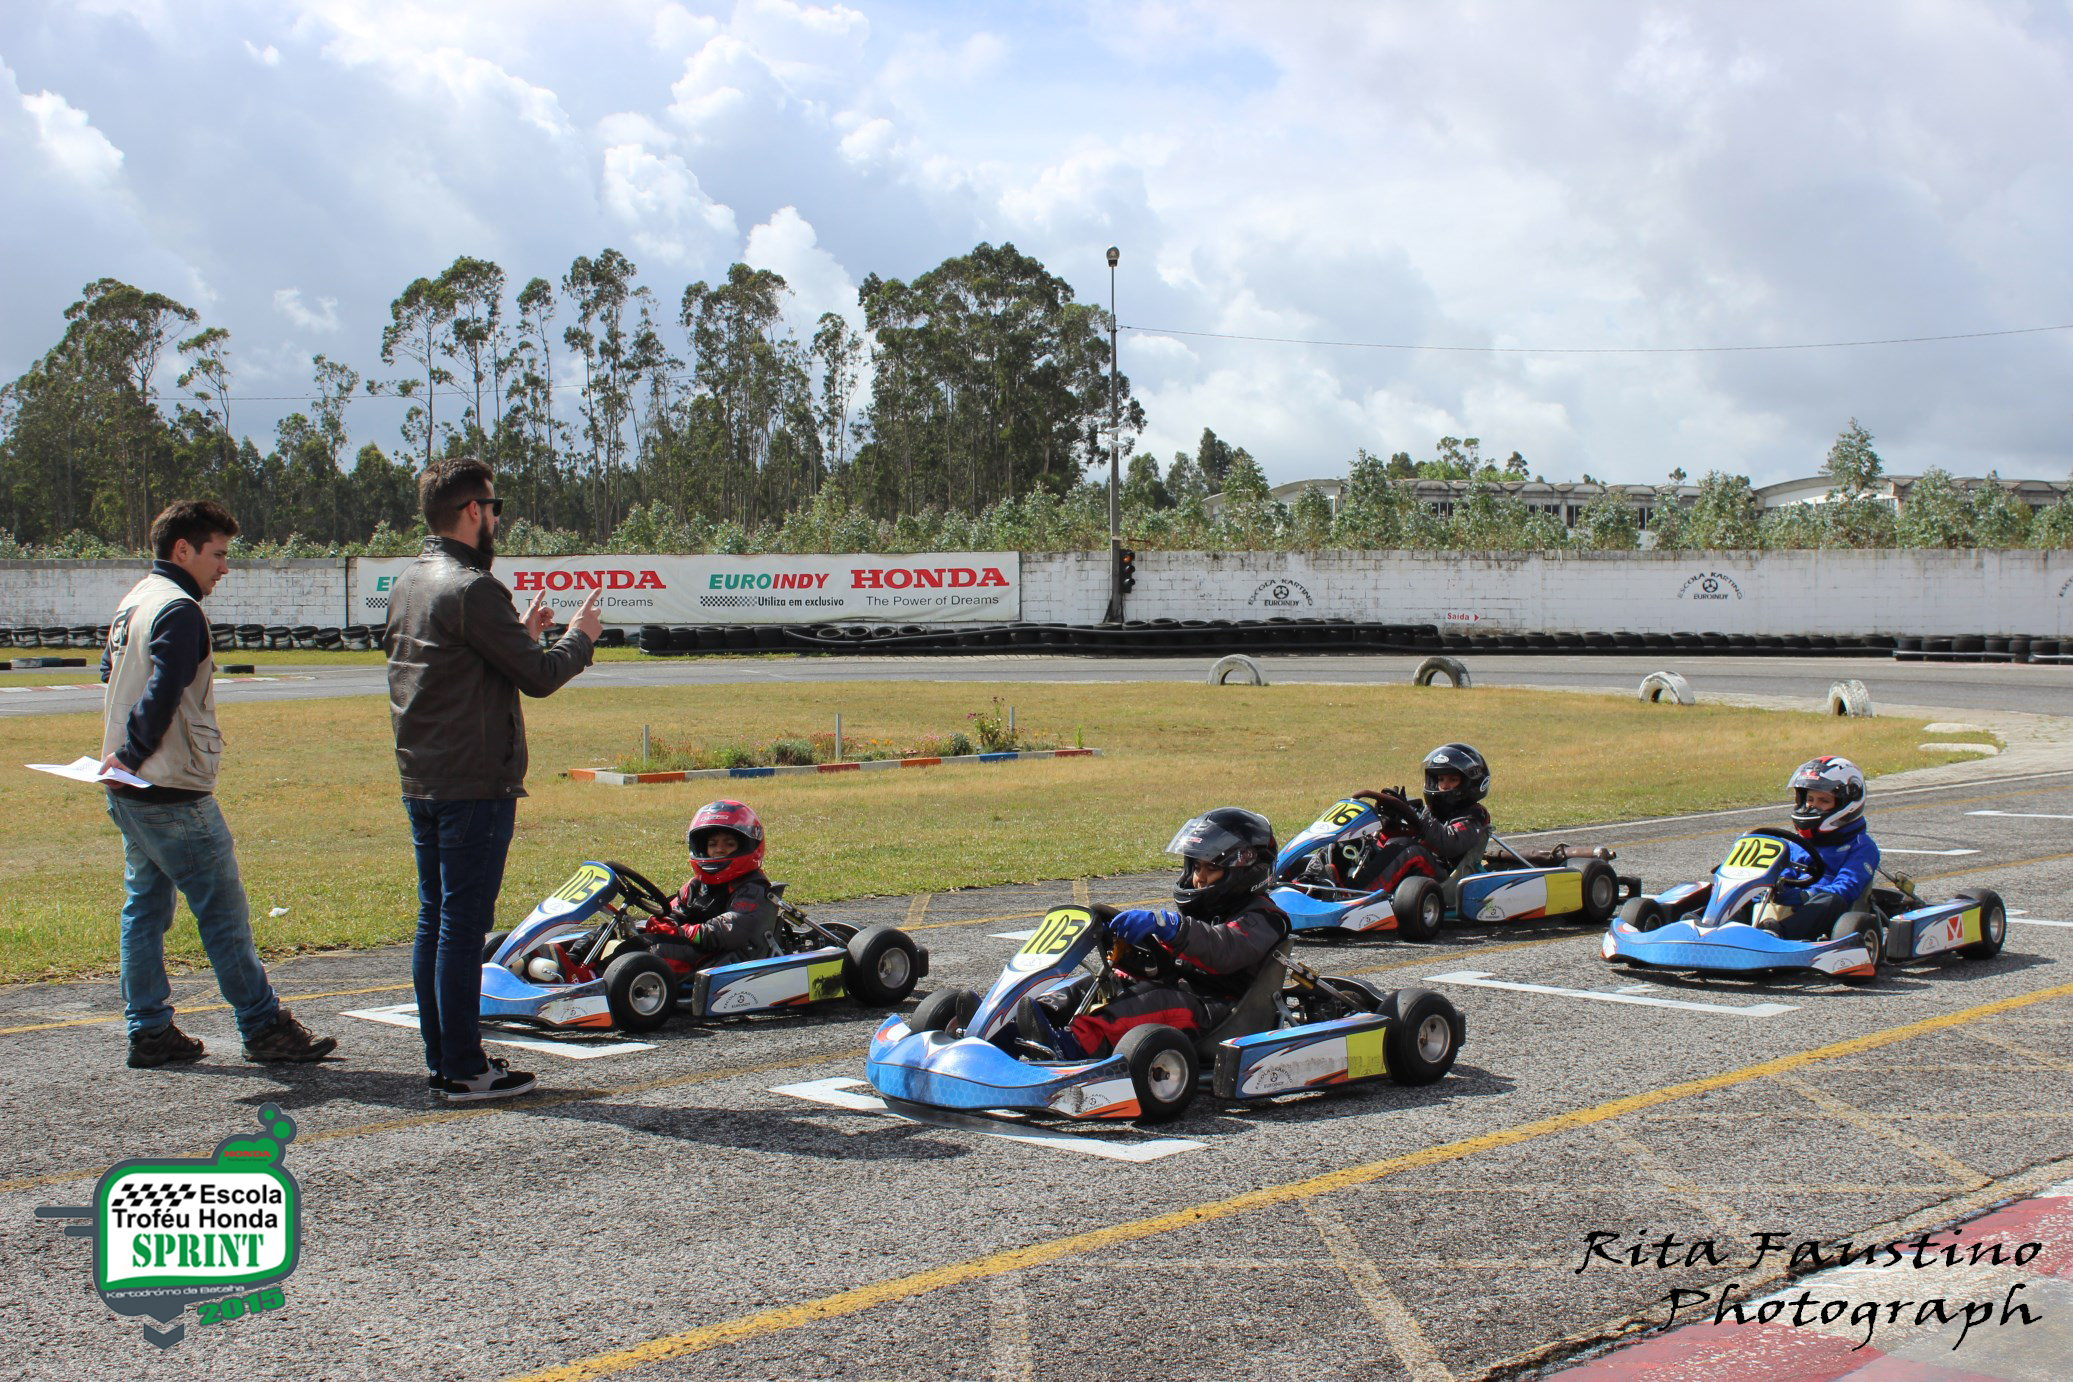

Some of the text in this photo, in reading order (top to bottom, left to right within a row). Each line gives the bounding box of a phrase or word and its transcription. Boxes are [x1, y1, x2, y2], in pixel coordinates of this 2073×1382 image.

[513, 570, 667, 591] HONDA
[708, 573, 830, 590] EUROINDY
[850, 567, 1010, 589] HONDA
[1677, 571, 1743, 600] ESCOLA KARTING
[525, 597, 548, 608] Te
[551, 597, 585, 608] Powe
[607, 596, 654, 607] Dreams
[757, 595, 844, 607] Utiliza em exclusivo
[866, 595, 1000, 606] The Power of Dreams
[1264, 599, 1299, 607] EUROINDY
[1281, 578, 1314, 607] KARTING
[1729, 838, 1781, 869] 102
[553, 869, 608, 905] 105
[1023, 914, 1086, 955] 103
